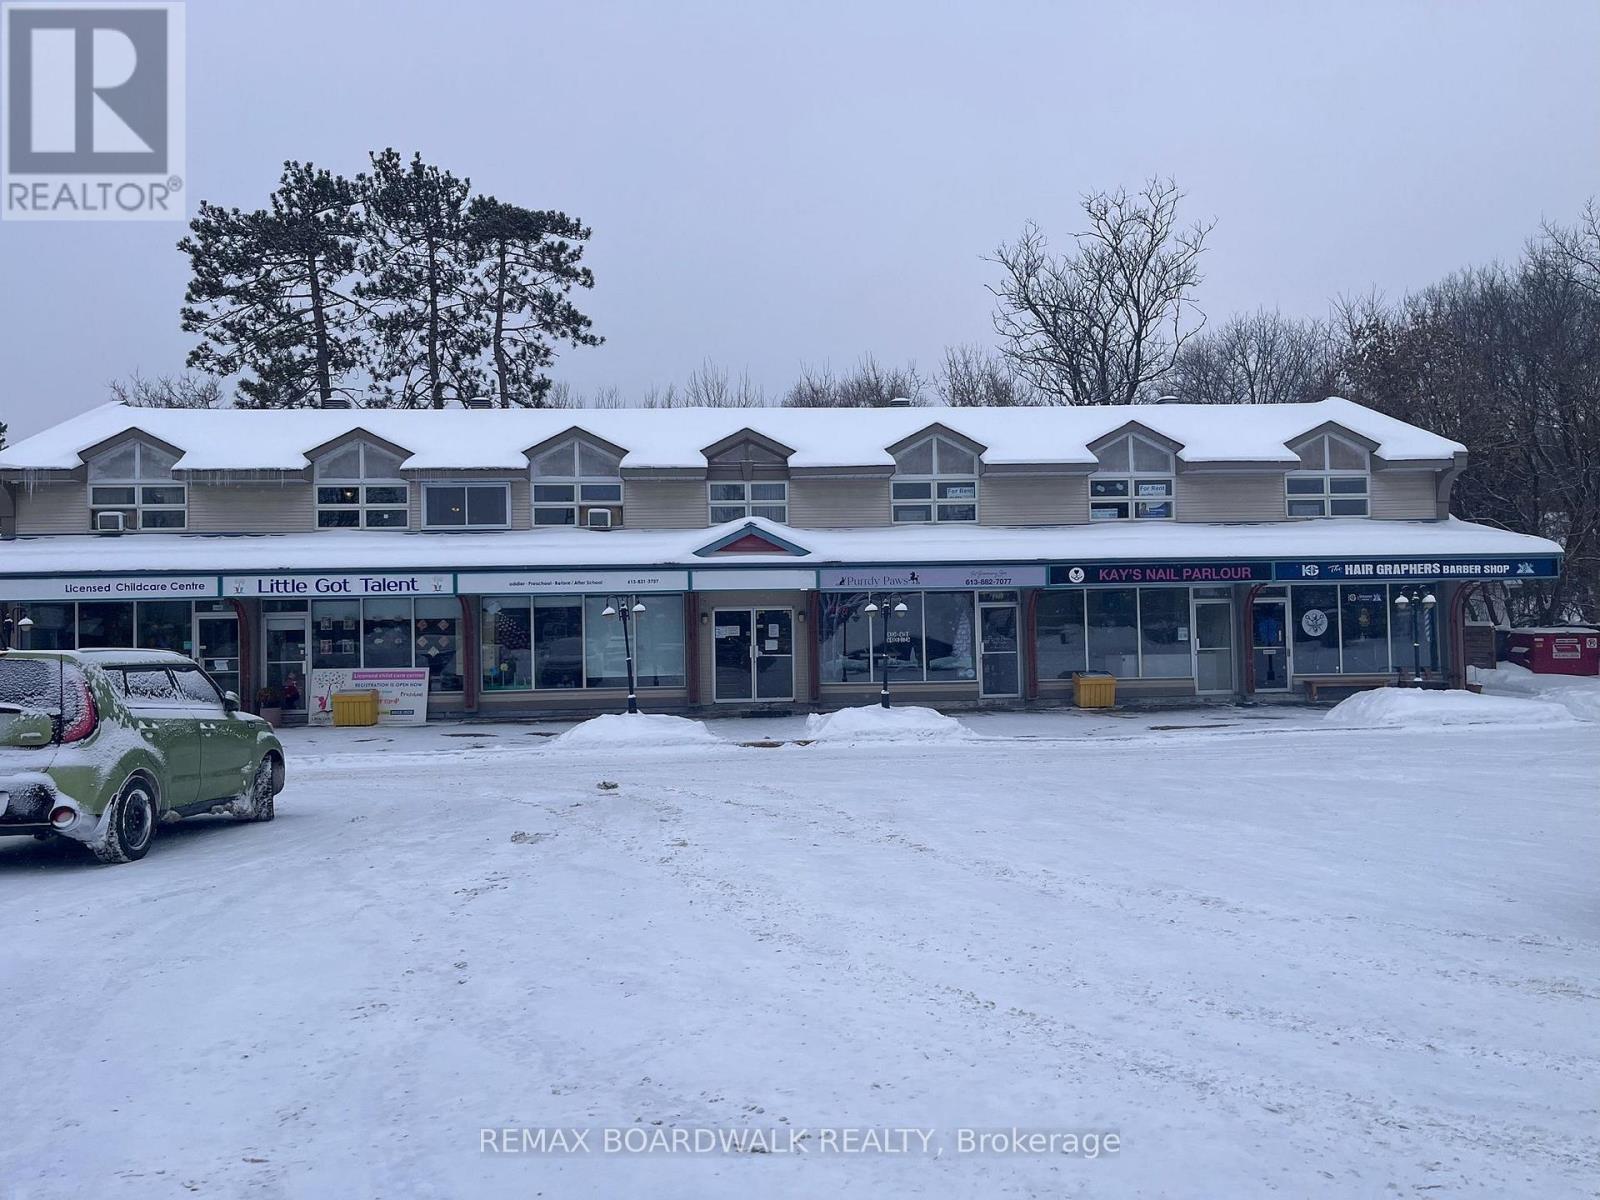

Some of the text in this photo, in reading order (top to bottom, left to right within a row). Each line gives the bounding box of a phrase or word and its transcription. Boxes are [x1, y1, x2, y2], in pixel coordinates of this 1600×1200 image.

[1099, 567, 1252, 581] KAY'S NAIL PARLOUR
[1328, 563, 1510, 575] The HAIR GRAPHERS BARBER SHOP
[257, 577, 419, 593] Little Got Talent
[882, 576, 909, 585] Paws
[65, 581, 206, 593] Licensed Childcare Centre
